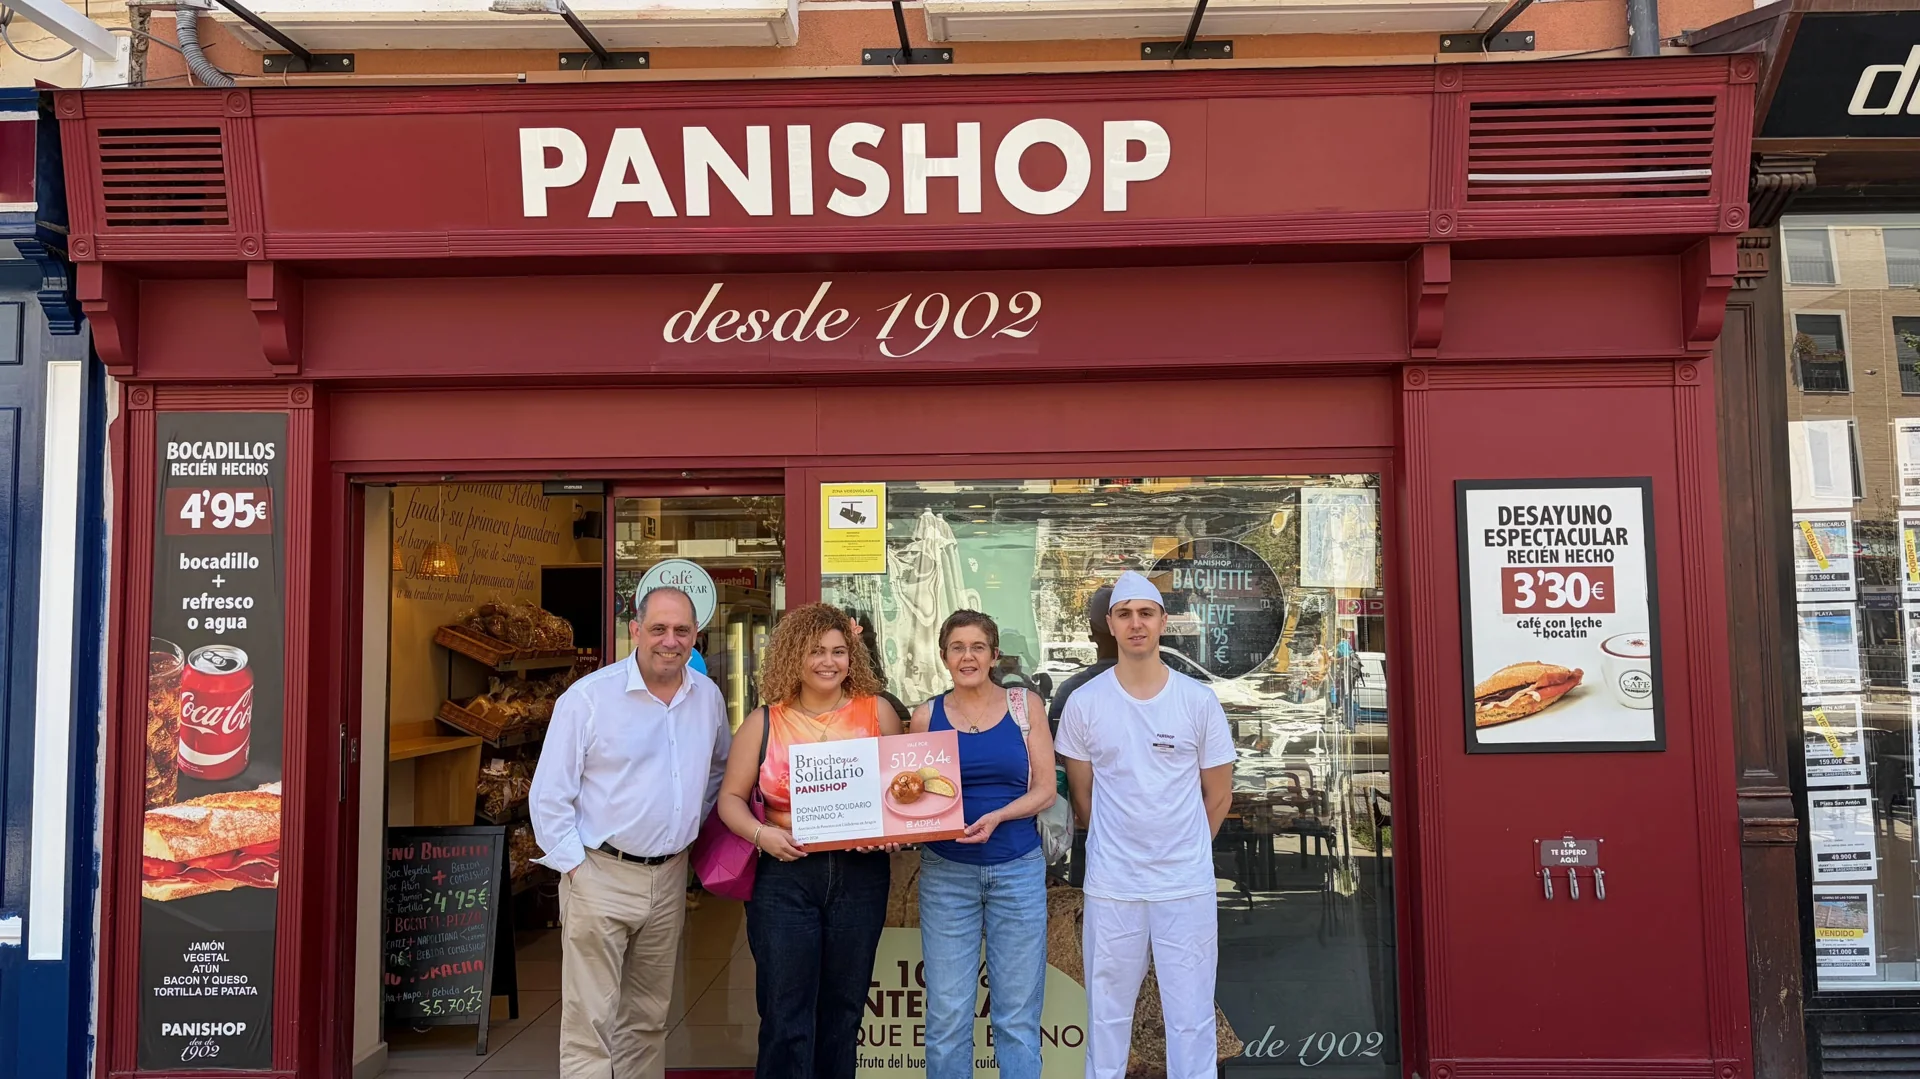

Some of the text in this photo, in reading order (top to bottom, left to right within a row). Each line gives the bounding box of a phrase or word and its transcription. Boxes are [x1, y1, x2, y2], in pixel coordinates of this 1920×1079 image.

[519, 118, 1171, 218] PANISHOP
[662, 282, 1042, 358] desde 1902
[167, 441, 275, 460] BOCADILLOS
[171, 460, 269, 476] RECIÉN HECHOS
[449, 510, 464, 527] su
[462, 506, 510, 541] primera
[1498, 505, 1613, 527] DESAYUNO
[1484, 527, 1628, 547] ESPECTACULAR
[1805, 528, 1824, 562] VENDIDO
[179, 553, 259, 569] bocadillo
[1507, 546, 1614, 564] RECIÉN HECHO
[1907, 539, 1917, 574] VENDIDO
[212, 574, 226, 588] +
[660, 570, 692, 585] Café
[1173, 568, 1253, 590] BAGUETTE
[182, 593, 254, 609] refresco
[1189, 603, 1235, 625] NIEVE
[187, 616, 247, 634] o agua
[1516, 616, 1602, 629] café con leche
[795, 764, 864, 784] Solidario
[795, 782, 847, 795] PANISHOP
[796, 800, 872, 815] DONATIVO SOLIDARIO
[796, 812, 836, 823] DESTINADO
[403, 864, 431, 881] Vegetal
[188, 940, 225, 951] JAMÓN
[417, 931, 459, 946] NAPOLITANA
[183, 953, 230, 962] VEGETAL
[192, 962, 219, 973] ATÚN
[163, 975, 248, 985] BACON Y QUESO
[154, 986, 258, 996] TORTILLA DE PATATA
[161, 1022, 247, 1036] PANISHOP
[180, 1045, 220, 1062] 1902
[1298, 1031, 1384, 1067] 1902
[887, 1053, 903, 1069] del
